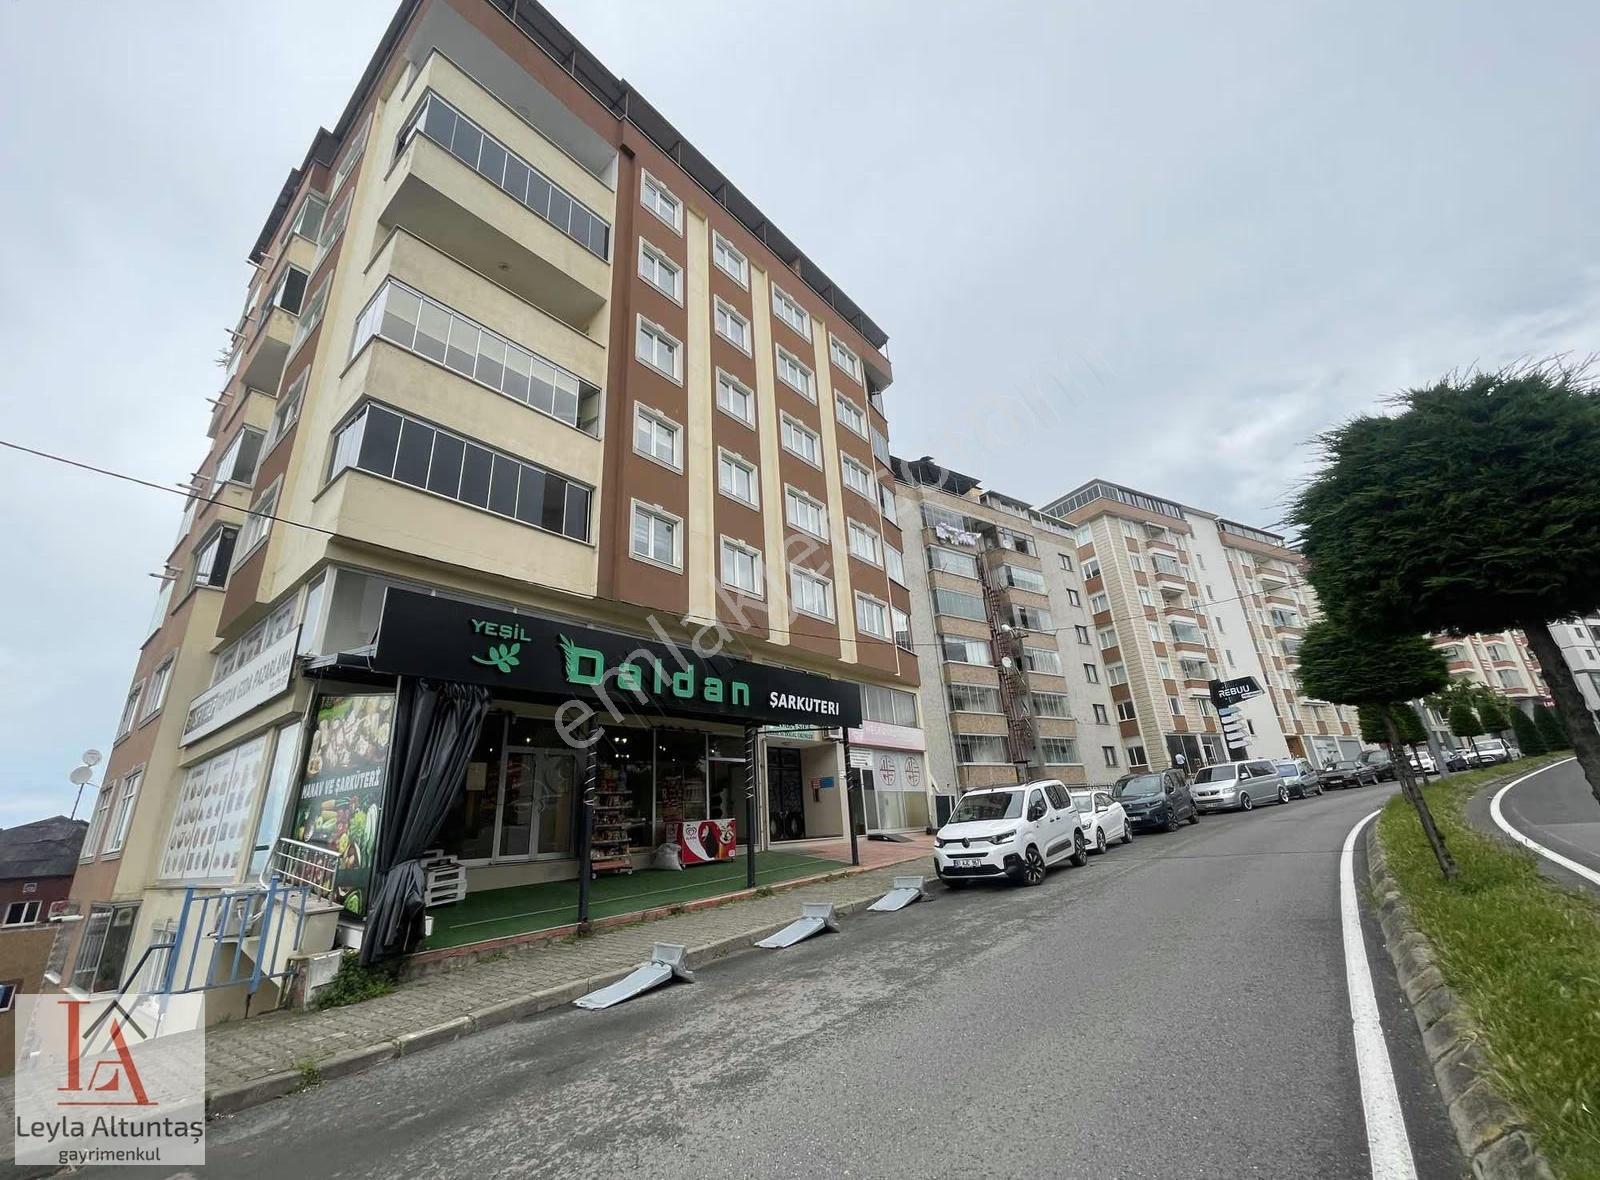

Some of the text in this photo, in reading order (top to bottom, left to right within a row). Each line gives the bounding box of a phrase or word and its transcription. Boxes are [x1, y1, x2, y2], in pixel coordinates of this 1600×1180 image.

[471, 618, 533, 643] YEŞİL
[1218, 685, 1250, 698] REBUU
[325, 778, 336, 796] VE
